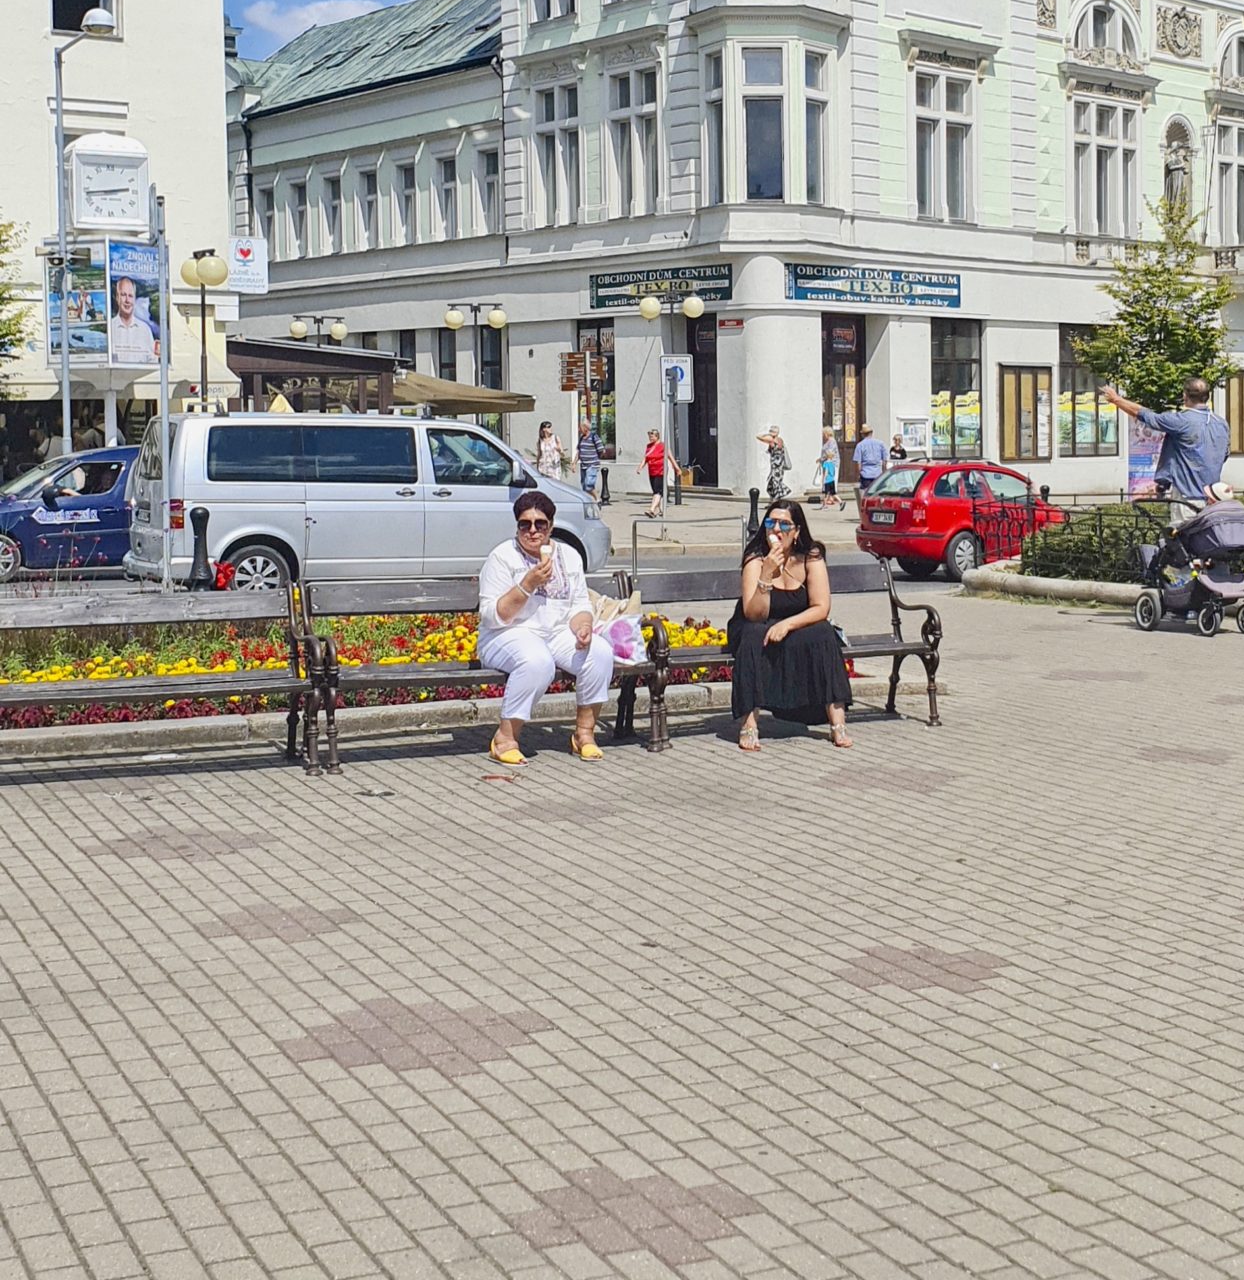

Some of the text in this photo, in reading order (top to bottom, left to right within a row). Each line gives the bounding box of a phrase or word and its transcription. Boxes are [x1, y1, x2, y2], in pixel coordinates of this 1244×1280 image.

[127, 252, 151, 261] ZNOVU
[597, 271, 647, 284] OBCHODNÍ
[649, 269, 672, 281] DŮM
[678, 266, 729, 279] CENTRUM
[797, 265, 863, 278] OBCHODNÍ
[865, 268, 893, 280] DŮM
[901, 272, 958, 285] CENTRUM
[847, 280, 913, 294] TEX-BO
